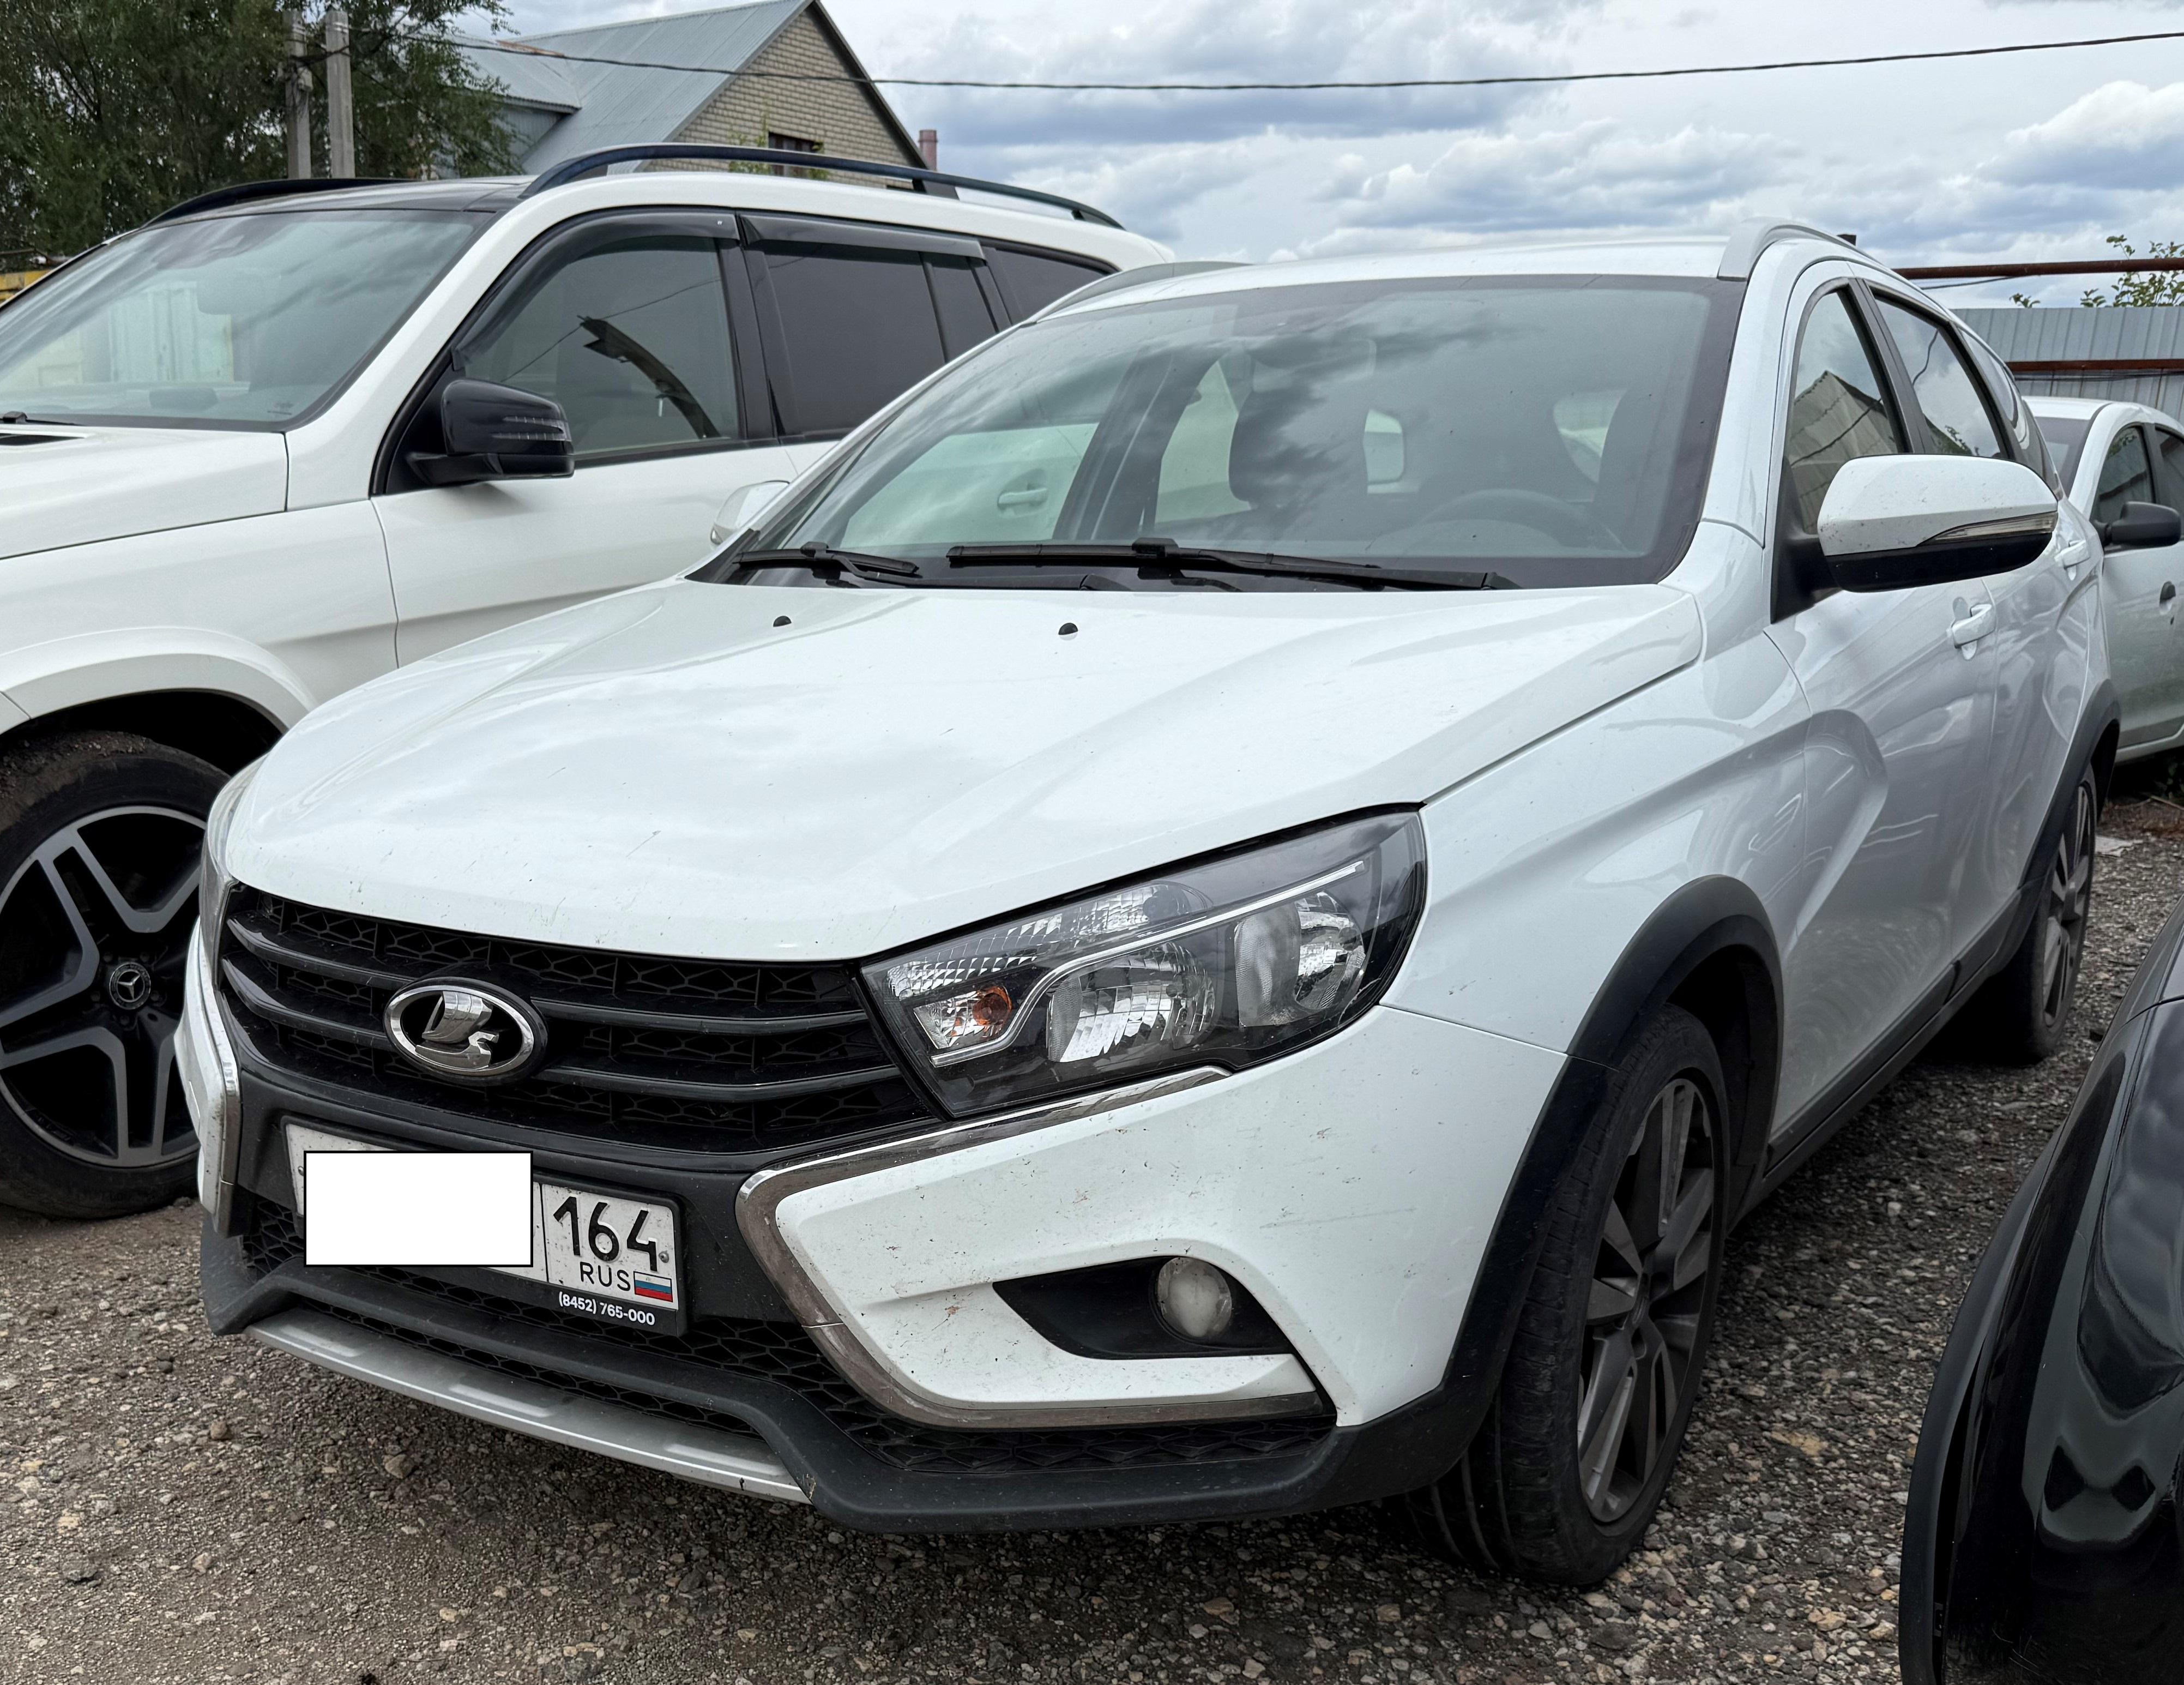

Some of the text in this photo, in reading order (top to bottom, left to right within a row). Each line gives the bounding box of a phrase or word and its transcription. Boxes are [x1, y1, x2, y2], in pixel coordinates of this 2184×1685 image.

[553, 1196, 658, 1272] 164
[580, 1261, 631, 1291] RUS
[559, 1291, 655, 1326] (8452) 765-000
